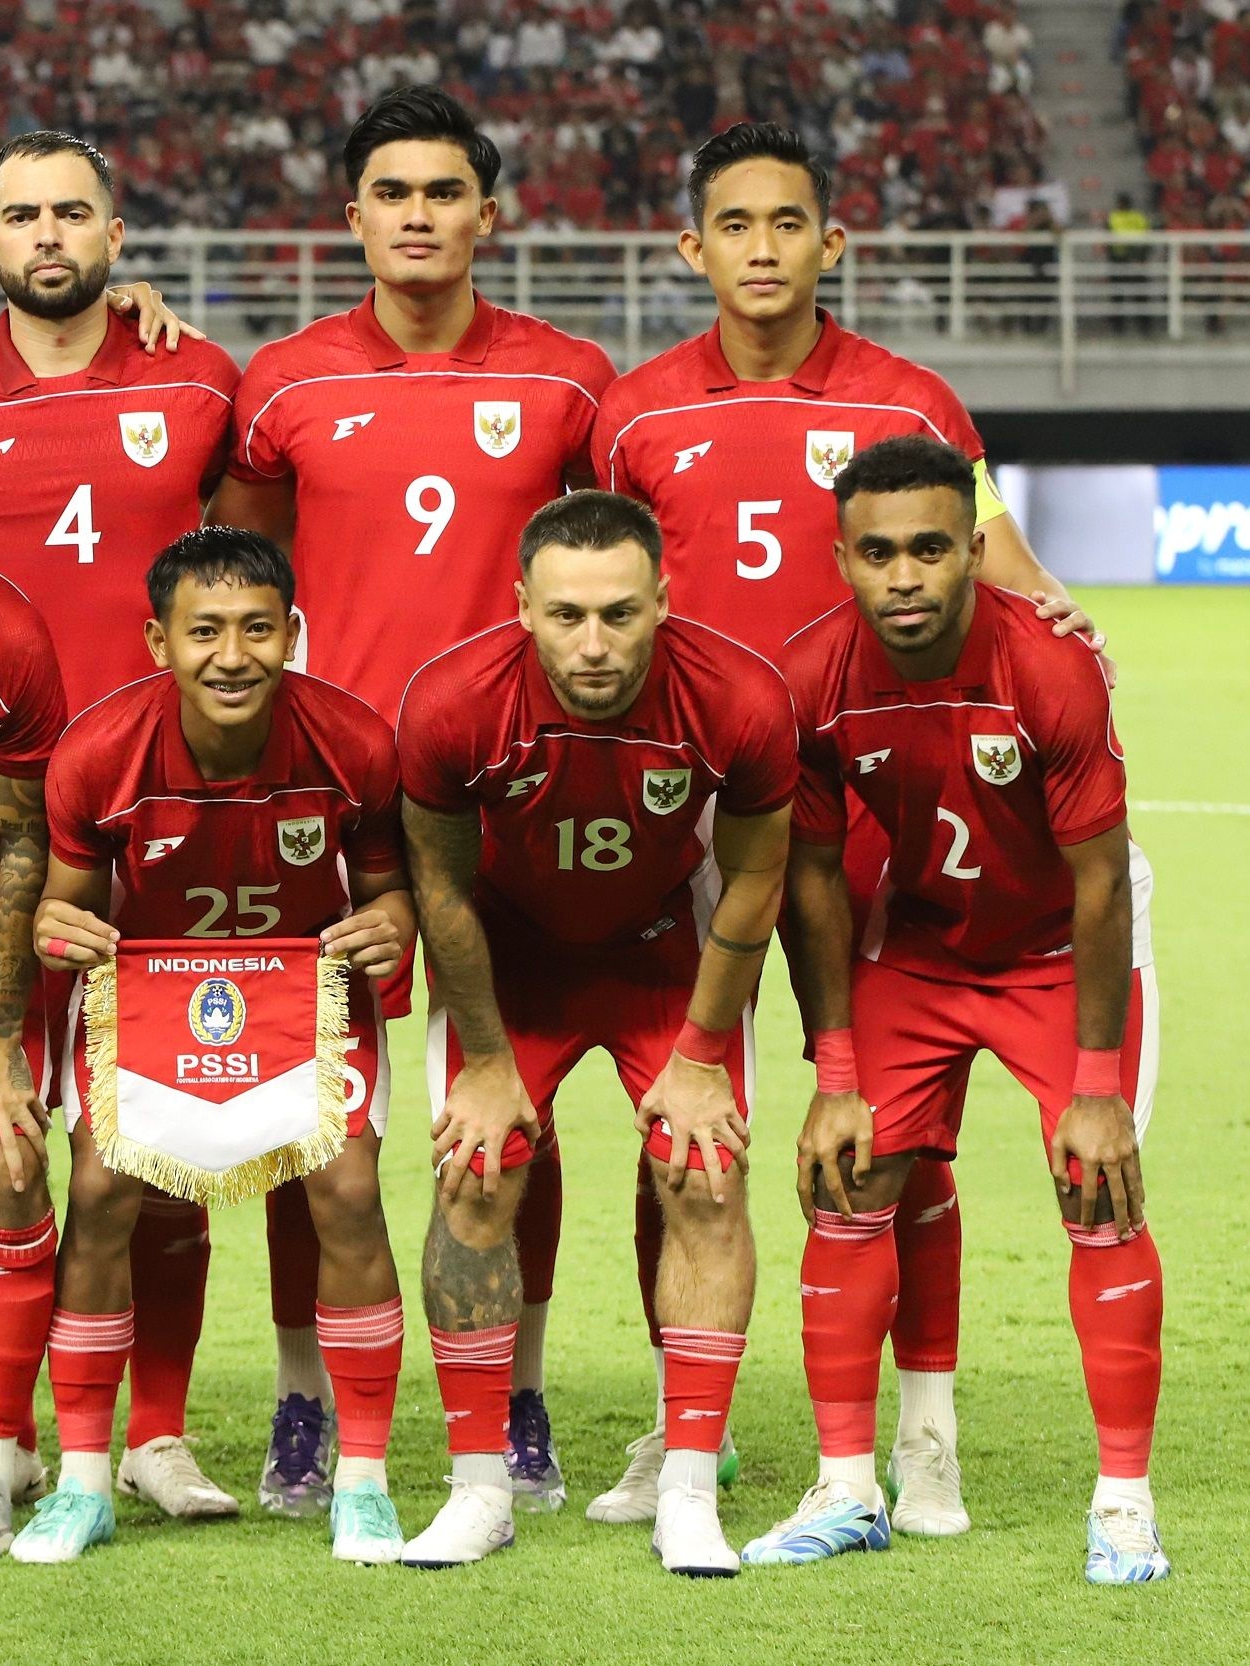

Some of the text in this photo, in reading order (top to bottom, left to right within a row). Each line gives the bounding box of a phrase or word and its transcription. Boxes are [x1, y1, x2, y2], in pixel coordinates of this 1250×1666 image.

[44, 483, 102, 564] 4
[404, 474, 456, 556] 9
[736, 499, 783, 581] 5
[554, 817, 633, 871] 18
[936, 806, 982, 880] 2
[183, 882, 281, 938] 25
[148, 957, 285, 973] INDONESIA
[207, 997, 228, 1006] PSSI
[176, 1053, 259, 1078] PSSI
